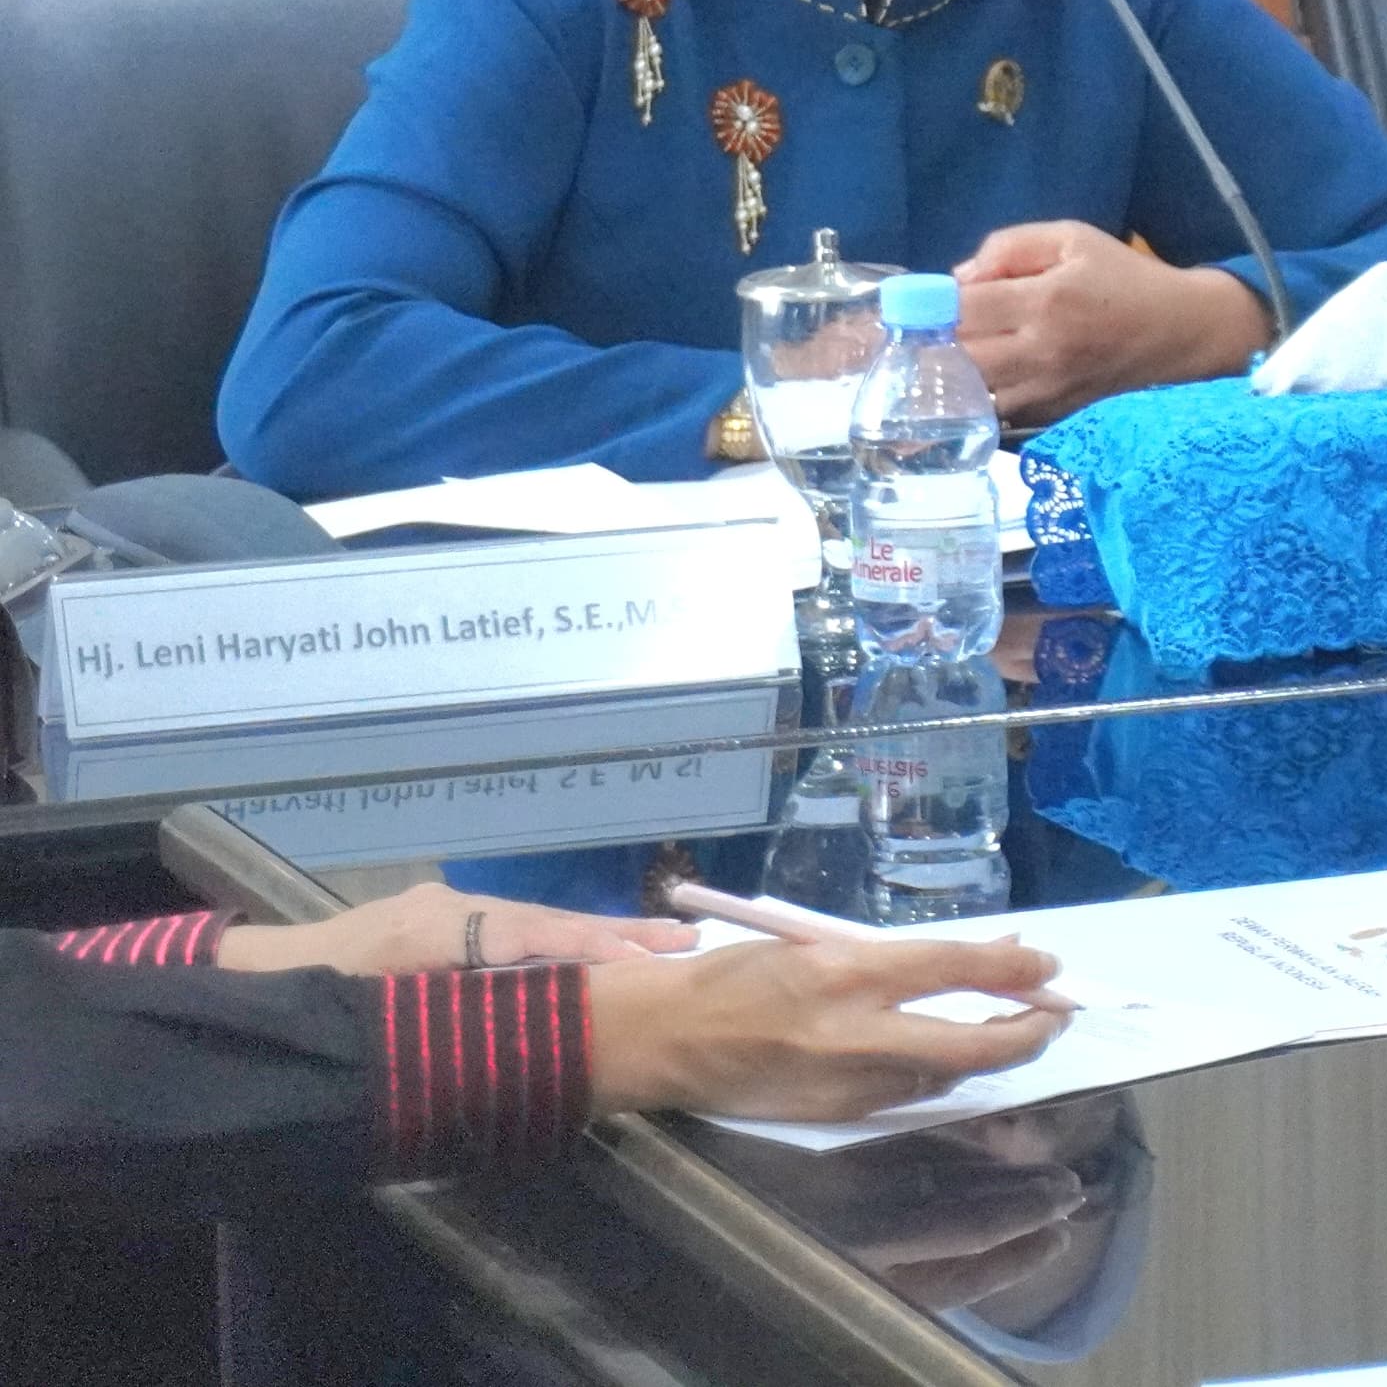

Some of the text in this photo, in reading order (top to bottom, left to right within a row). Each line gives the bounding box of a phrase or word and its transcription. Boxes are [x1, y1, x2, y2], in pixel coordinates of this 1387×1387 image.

[870, 535, 894, 562] Le
[78, 642, 124, 679] Hj.
[135, 634, 206, 668] Leni
[216, 622, 342, 663] Haryati
[352, 617, 431, 650] John
[440, 606, 545, 642] Latief,
